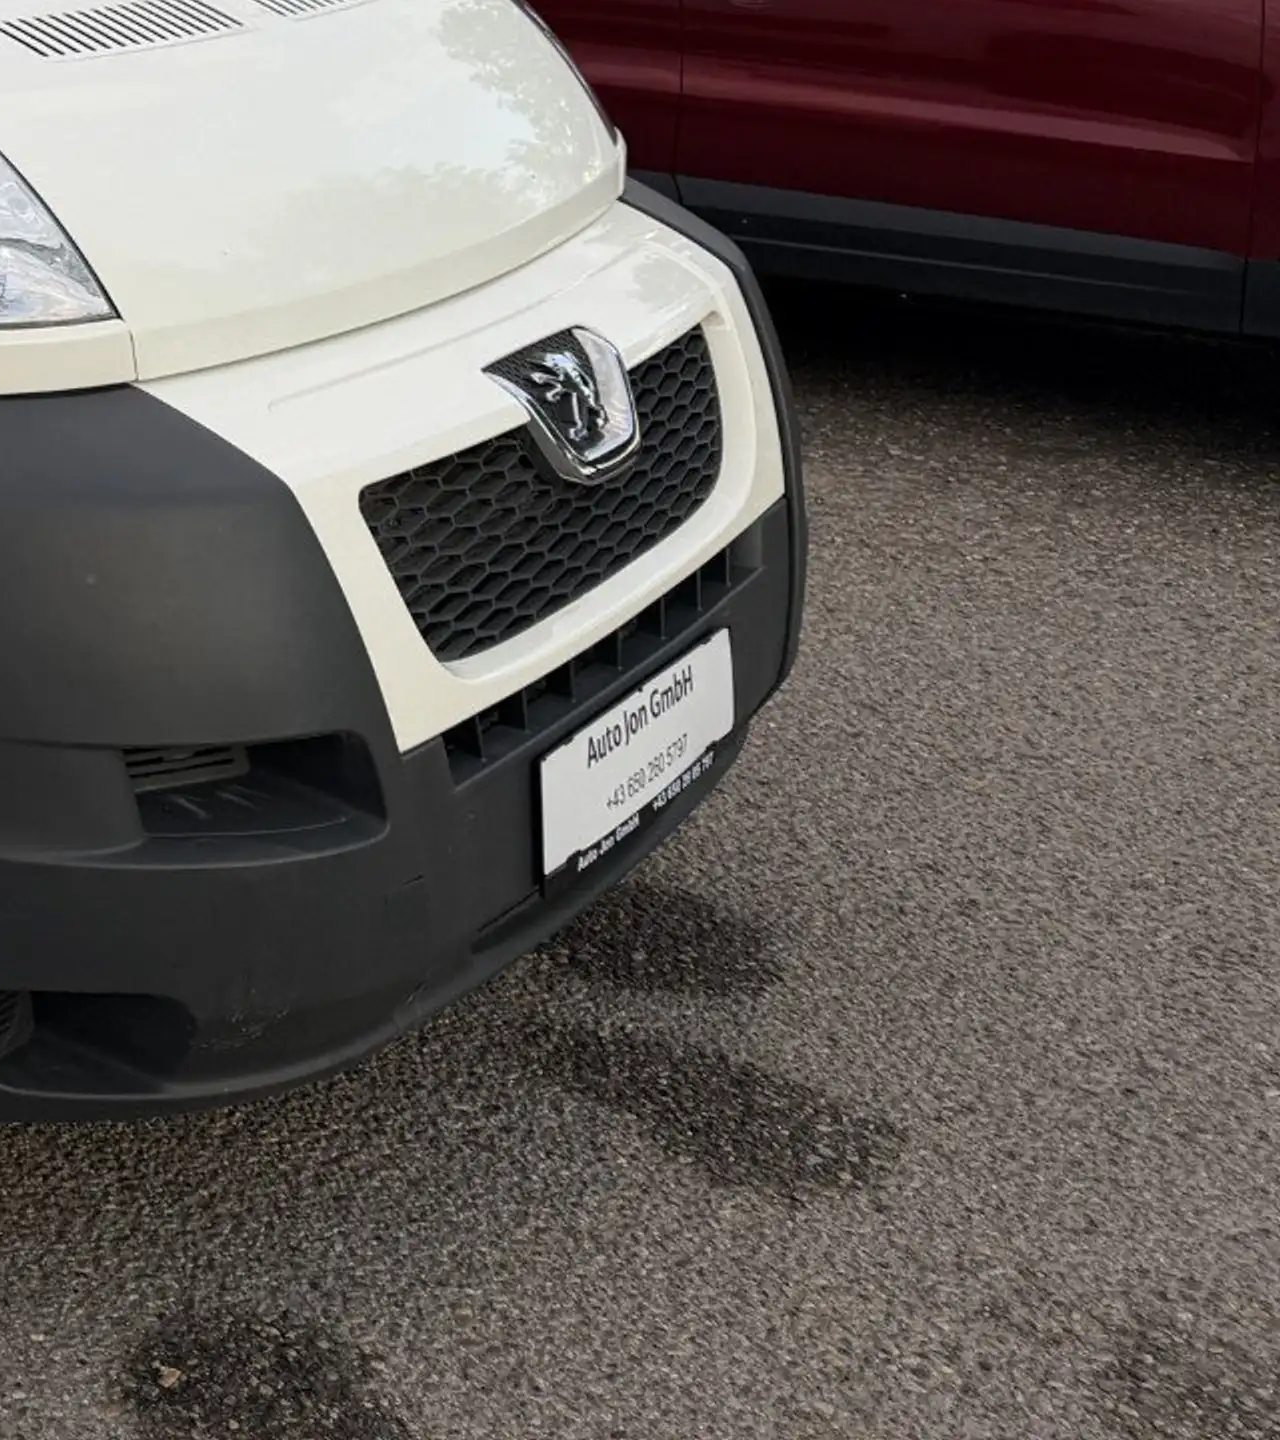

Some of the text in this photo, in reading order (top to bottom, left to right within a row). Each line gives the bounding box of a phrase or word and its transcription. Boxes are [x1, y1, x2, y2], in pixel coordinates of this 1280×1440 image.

[587, 664, 694, 769] Auto Jon GmbH
[606, 783, 626, 810] +43
